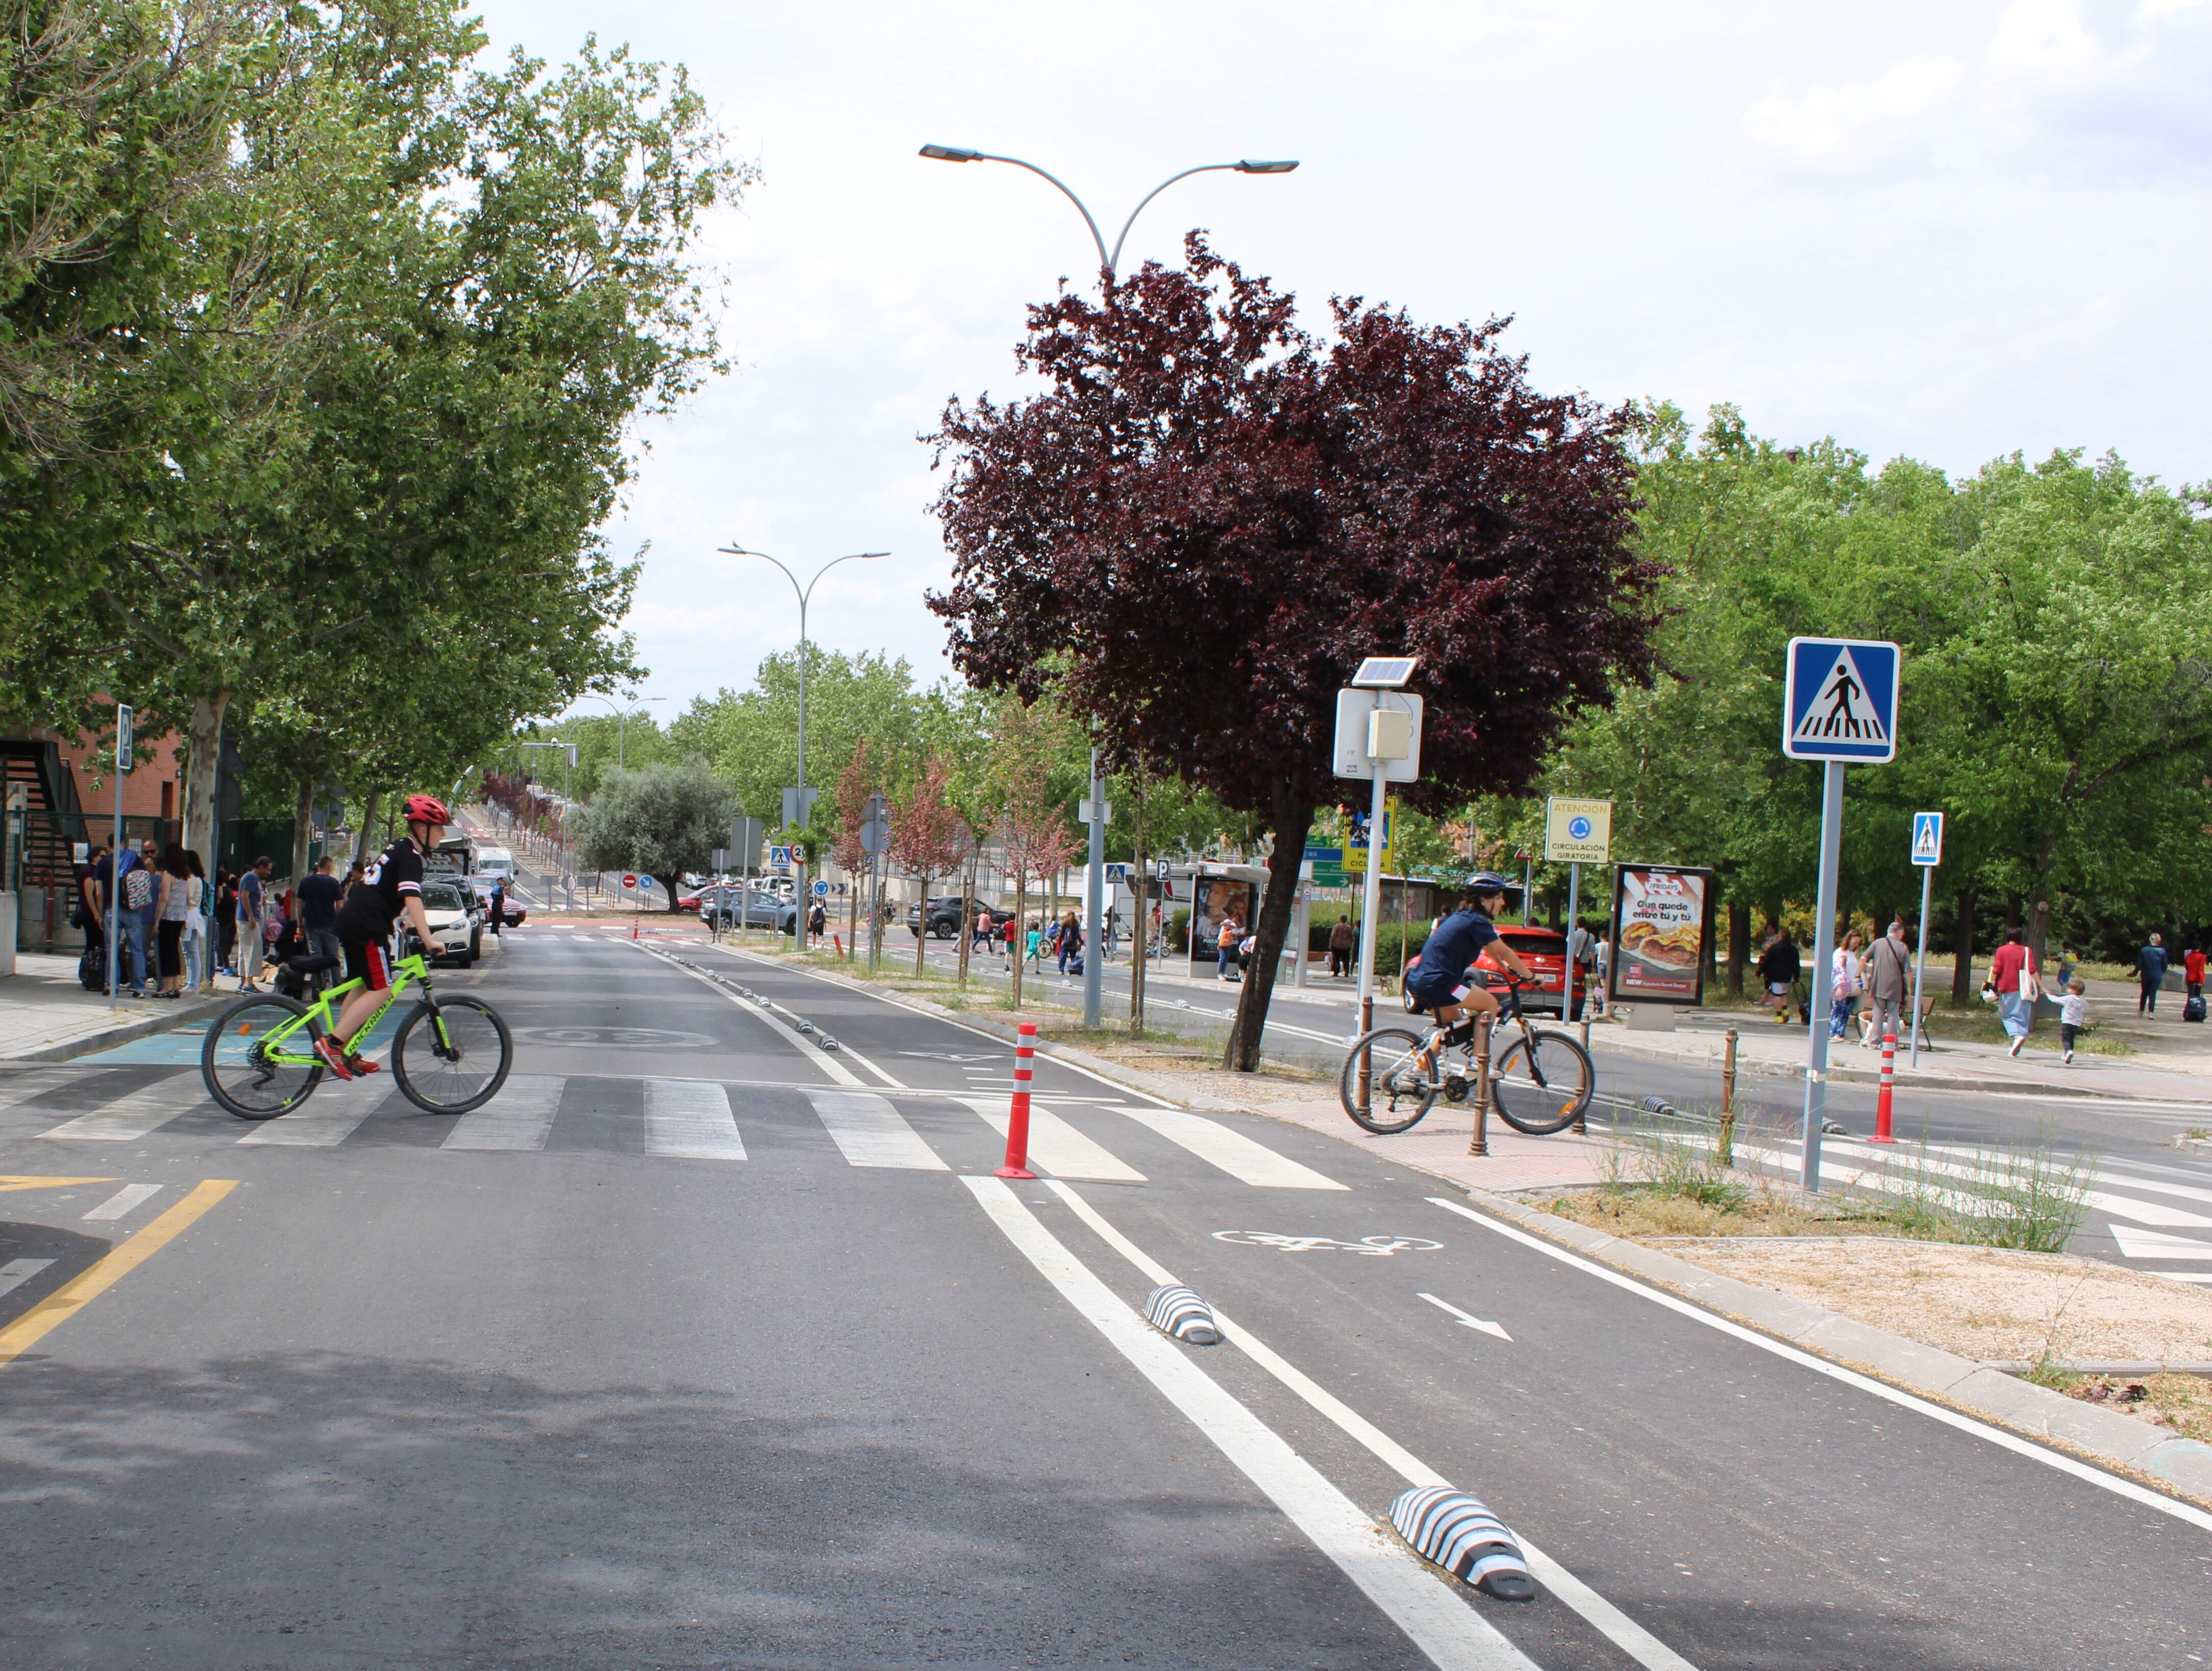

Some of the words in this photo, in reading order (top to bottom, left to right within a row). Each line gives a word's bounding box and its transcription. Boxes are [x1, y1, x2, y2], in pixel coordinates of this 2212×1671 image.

[1554, 804, 1607, 813] ATENCIÓN
[1552, 843, 1605, 852] CIRCULACIÓN
[1159, 862, 1167, 879] P
[1637, 900, 1656, 908] Que
[1658, 902, 1688, 911] quede
[1633, 911, 1658, 919] entre
[1660, 912, 1670, 920] tú
[1681, 913, 1692, 921] tú
